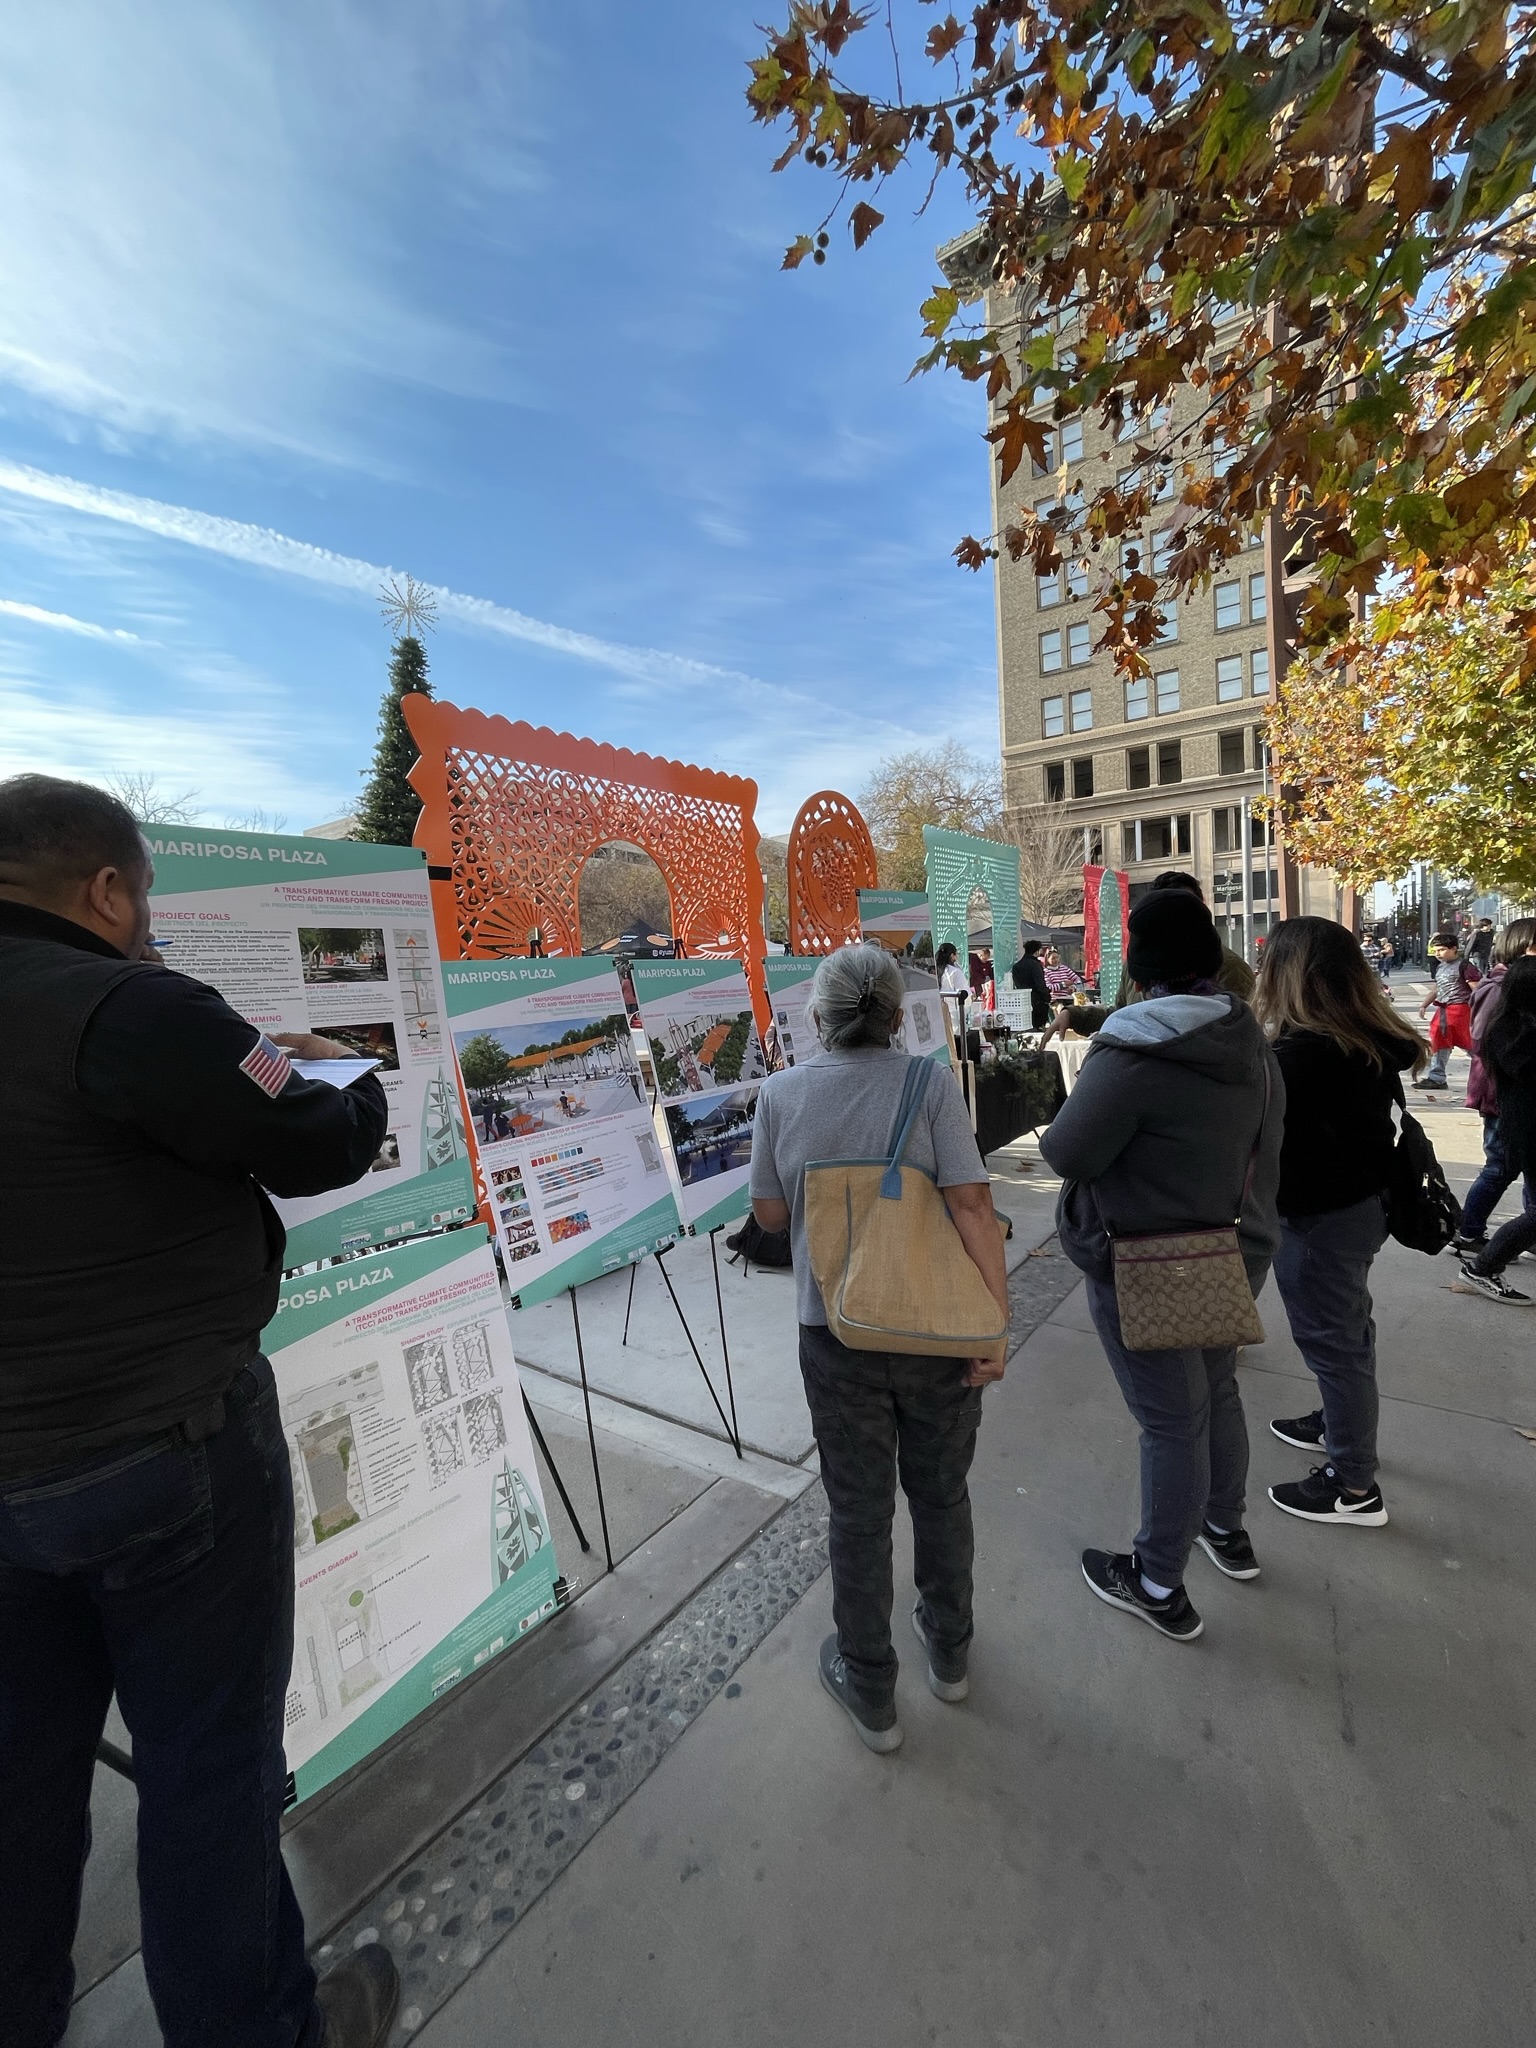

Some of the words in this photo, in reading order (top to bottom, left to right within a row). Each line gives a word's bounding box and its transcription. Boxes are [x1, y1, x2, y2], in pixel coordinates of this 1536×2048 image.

[149, 839, 262, 861] MARIPOSA
[268, 848, 328, 866] PLAZA
[282, 886, 349, 897] TRANSFORMATIVE
[351, 890, 380, 898] CLIMATE
[382, 892, 428, 900] COMMUNITIES
[284, 894, 306, 902] (TCC)
[326, 896, 370, 904] TRANSFORM
[372, 898, 400, 906] FRESNO
[861, 896, 888, 904] MARIPOSA
[152, 912, 196, 920] PROJECT
[448, 970, 518, 985] MARIPOSA
[520, 968, 556, 980] PLAZA
[638, 969, 681, 978] MARIPOSA
[684, 968, 706, 977] PLAZA
[768, 964, 797, 972] MARIPOSA
[245, 1015, 282, 1024] AMMING
[276, 1286, 332, 1315] POSA
[336, 1267, 394, 1295] PLAZA
[352, 1298, 418, 1325] TRANSFORMATIVE
[419, 1288, 447, 1302] CLIMATE
[449, 1271, 494, 1291] COMMUNITIES
[356, 1320, 376, 1332] (TCC)
[378, 1314, 393, 1324] AND
[395, 1298, 438, 1318] TRANSFORM
[440, 1288, 467, 1302] FRESNO
[469, 1278, 495, 1292] PROJECT
[400, 1333, 425, 1346] SHADOW
[427, 1327, 444, 1337] STUDY
[299, 1568, 326, 1588] EVENTS
[328, 1550, 358, 1572] DIAGRAM
[367, 1576, 394, 1594] CHRISTMAS
[408, 1554, 430, 1571] LOCATION
